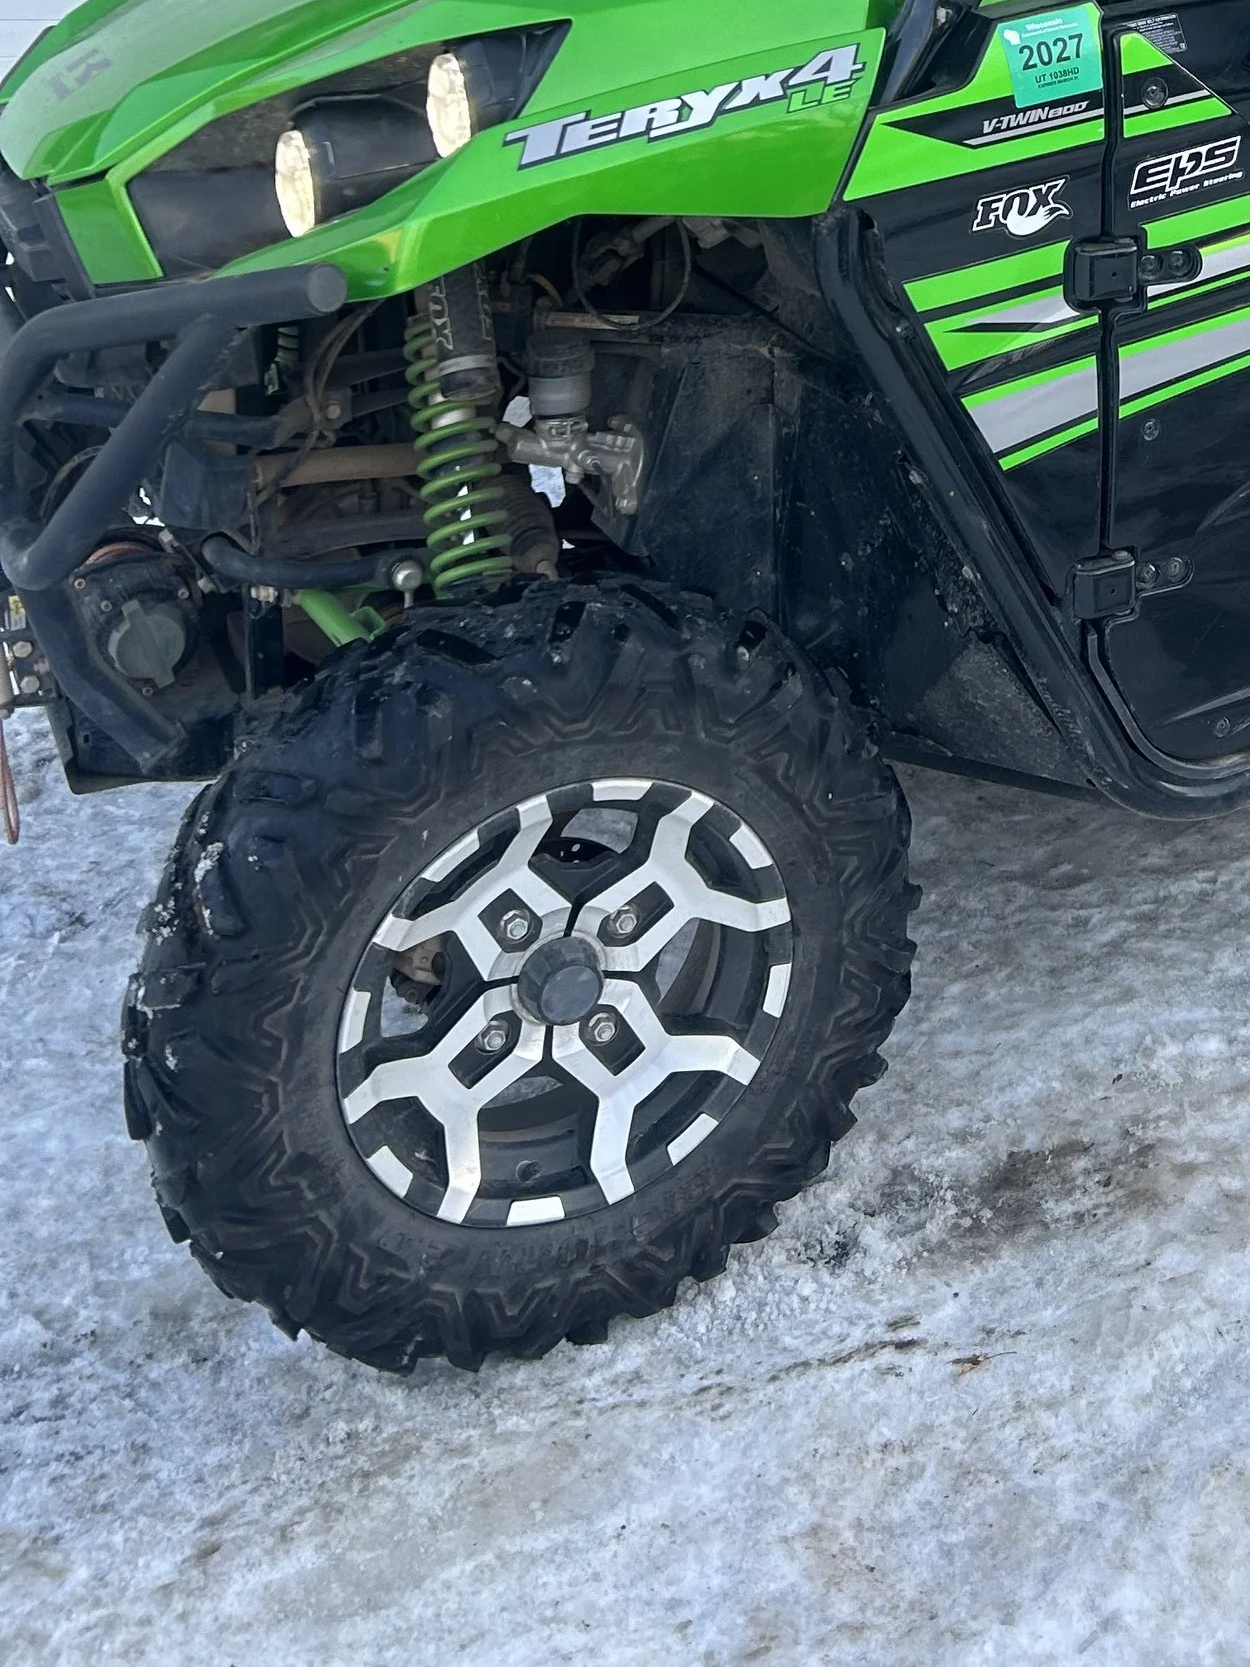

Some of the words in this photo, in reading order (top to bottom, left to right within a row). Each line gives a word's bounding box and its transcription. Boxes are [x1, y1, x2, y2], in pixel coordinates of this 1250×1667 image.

[1025, 17, 1064, 32] Wisconsin
[1018, 32, 1083, 72] 2027
[786, 76, 863, 114] LE
[1034, 74, 1047, 84] UT
[502, 43, 866, 171] TERYX4
[1129, 135, 1242, 196] EPS
[972, 178, 1070, 236] FOX
[1130, 192, 1167, 209] Electric
[1169, 183, 1201, 197] Power
[1203, 171, 1244, 188] Steering
